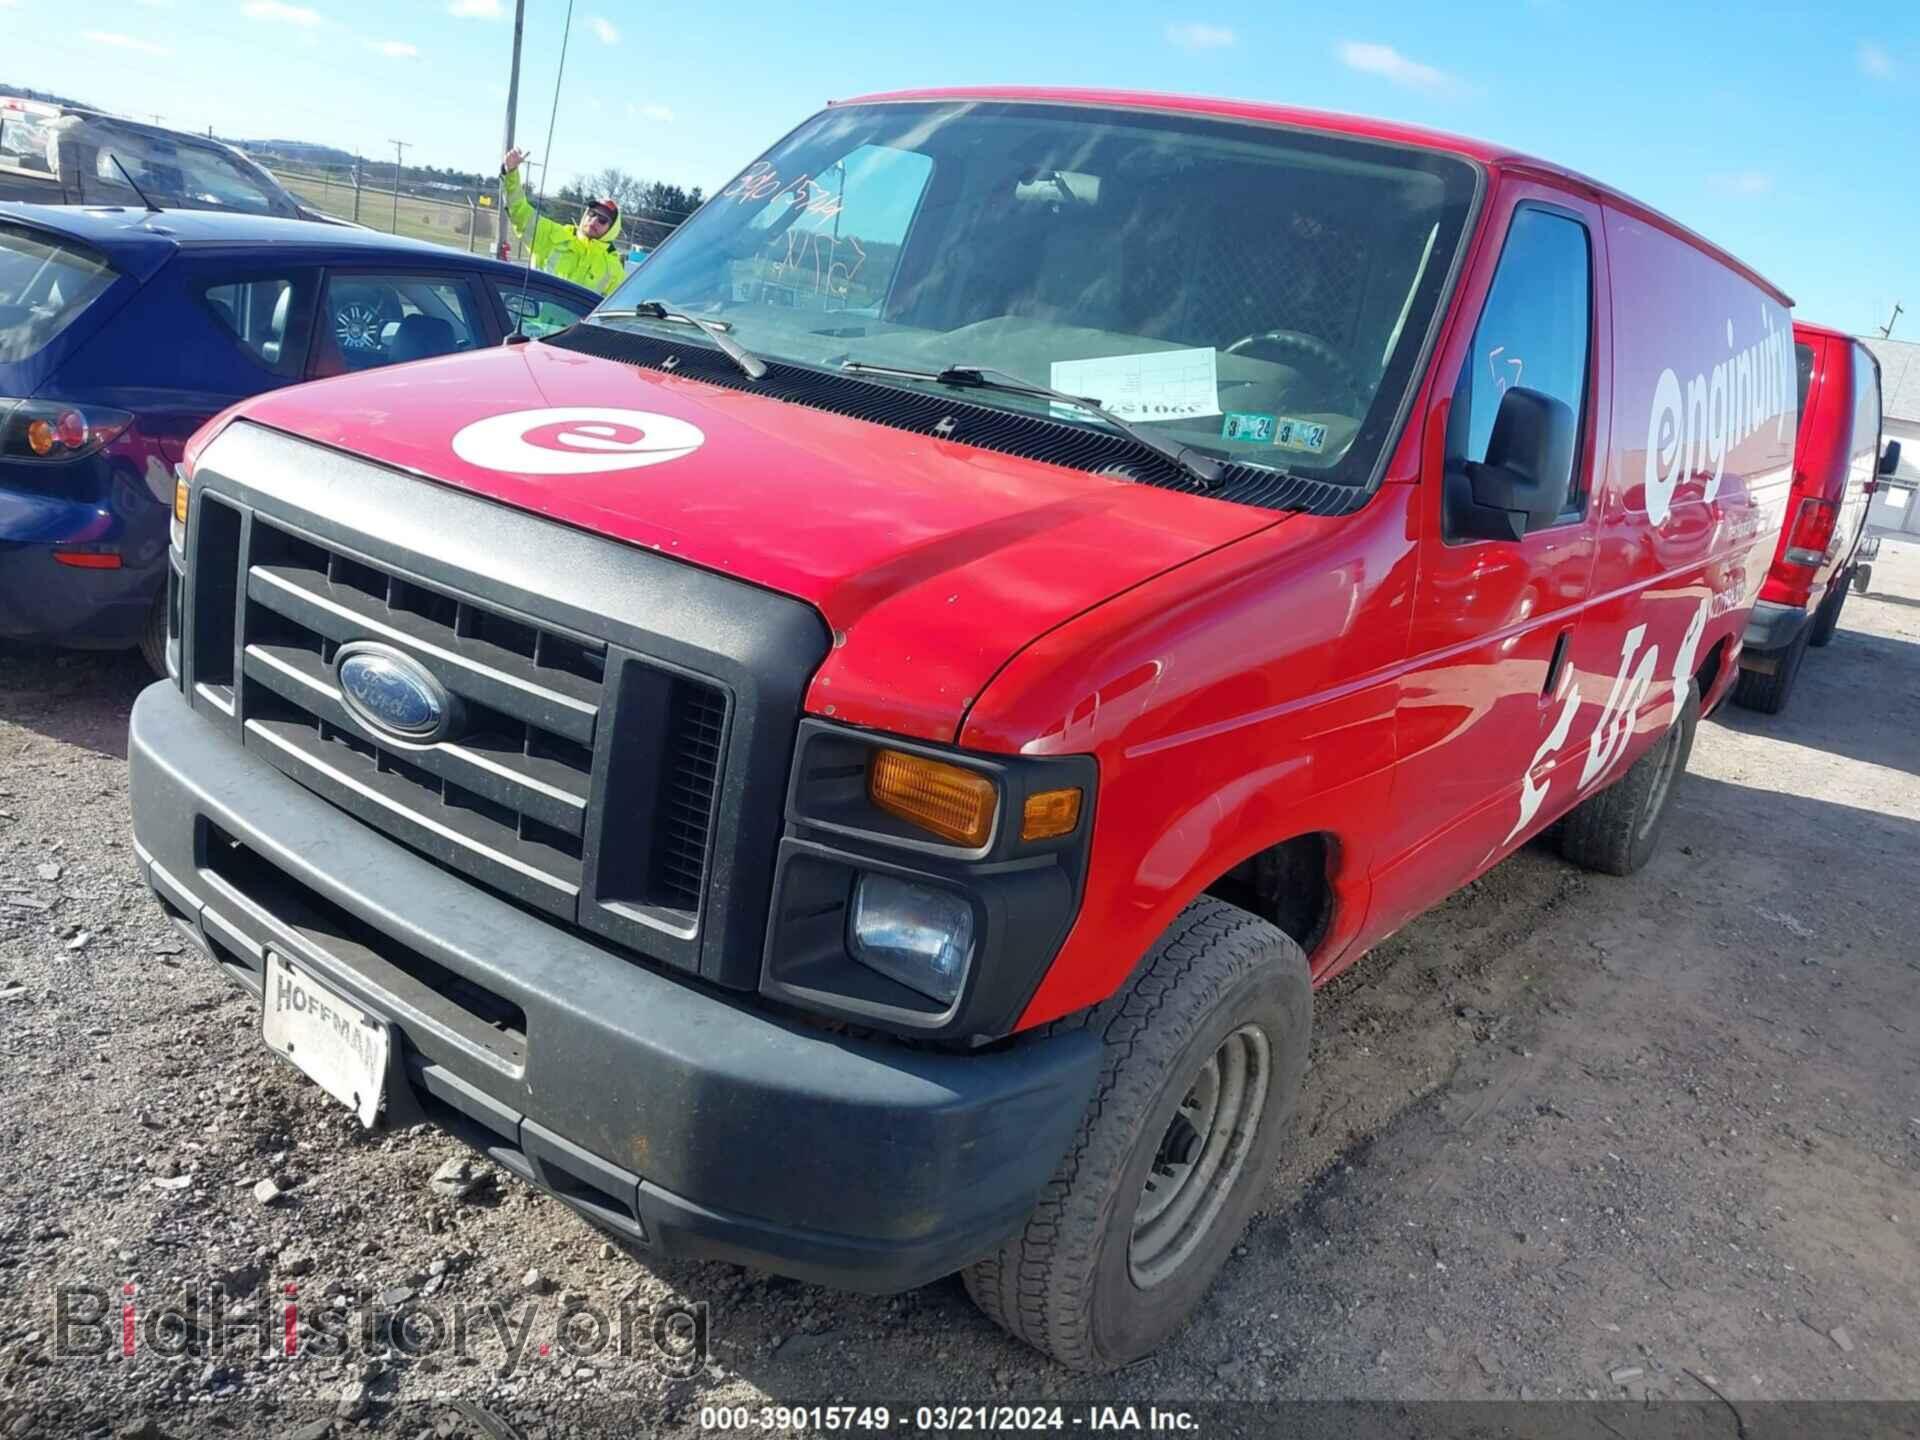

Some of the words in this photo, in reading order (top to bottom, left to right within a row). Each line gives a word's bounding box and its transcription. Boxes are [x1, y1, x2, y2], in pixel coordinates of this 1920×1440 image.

[1228, 420, 1238, 437] 3
[1257, 418, 1272, 438] 24
[1280, 425, 1291, 443] 3
[1310, 427, 1325, 447] 24
[1645, 303, 1788, 527] enginuity
[276, 974, 380, 1086] HOFFMAN
